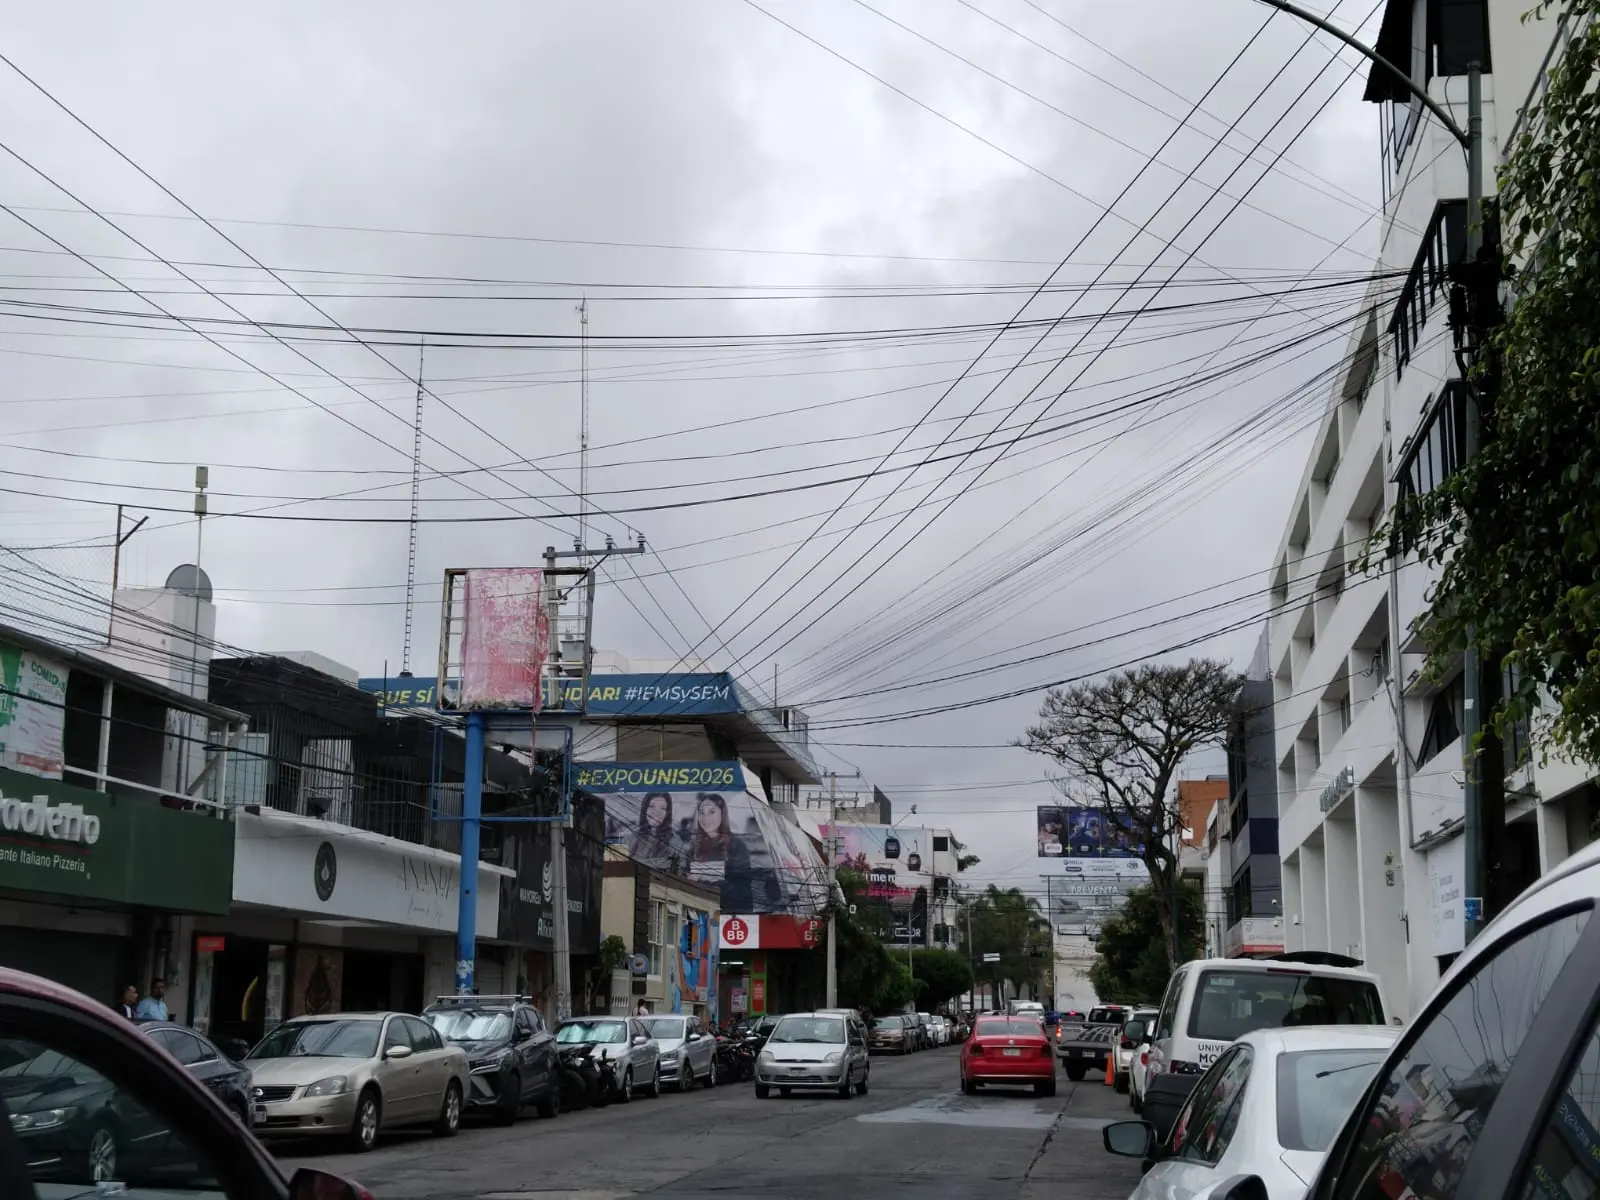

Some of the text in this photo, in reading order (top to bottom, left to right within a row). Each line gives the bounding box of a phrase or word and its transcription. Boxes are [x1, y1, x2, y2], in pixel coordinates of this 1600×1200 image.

[415, 686, 435, 704] SÍ
[624, 685, 730, 703] #IEMSySEM
[576, 767, 735, 786] #EXPOUNIS2026
[20, 849, 51, 868] Italiano
[53, 854, 86, 873] Pizzeria
